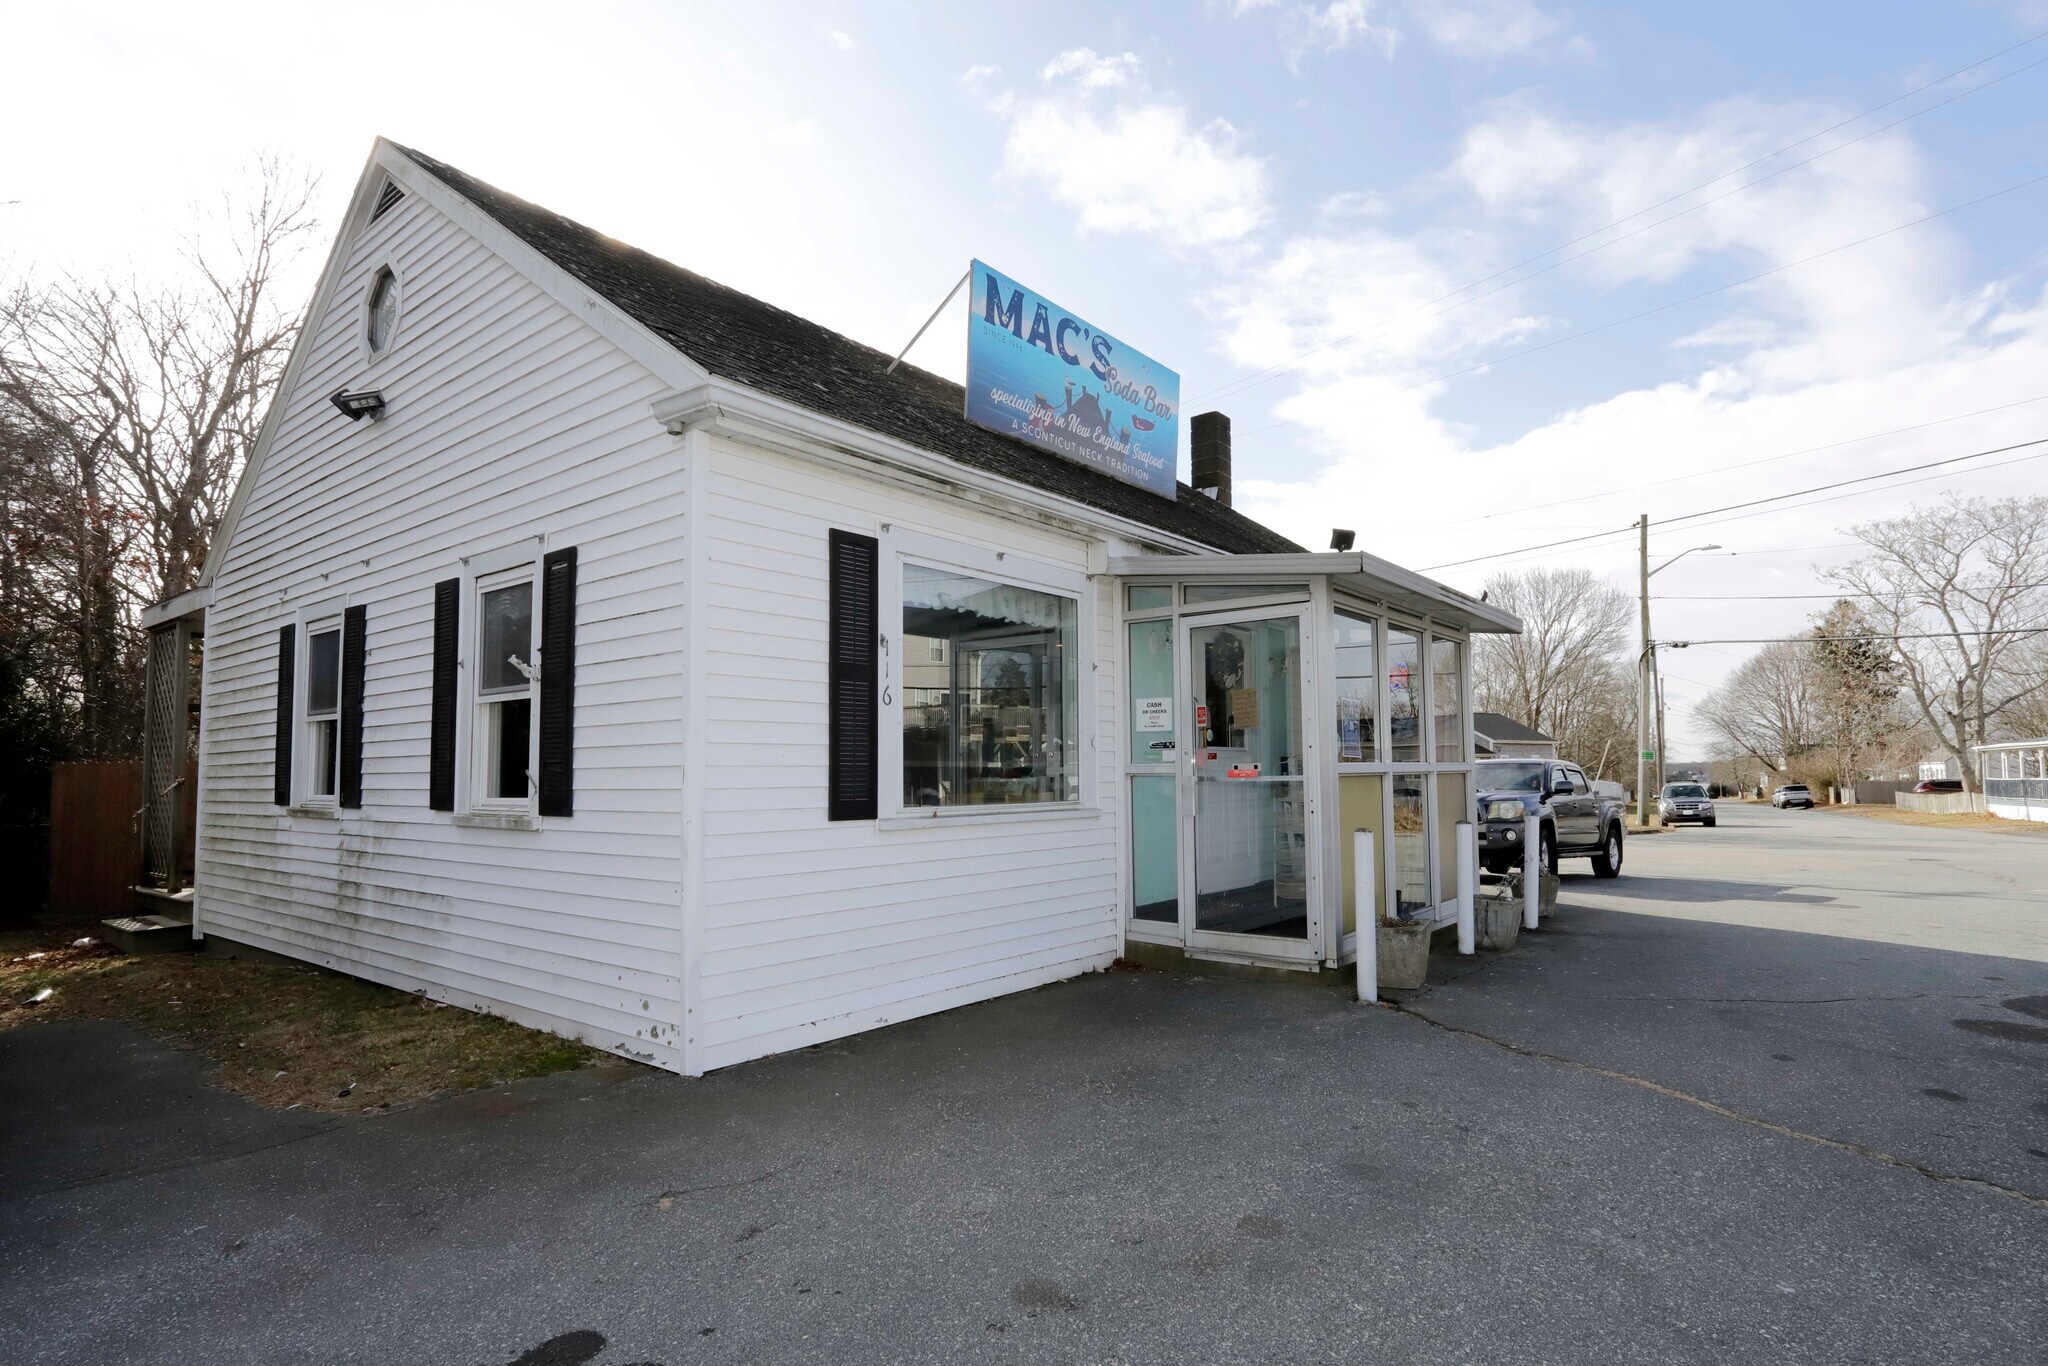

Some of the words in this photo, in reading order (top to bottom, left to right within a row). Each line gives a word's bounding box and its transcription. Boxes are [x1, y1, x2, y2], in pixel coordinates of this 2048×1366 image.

[983, 272, 1113, 381] MAC'S
[983, 325, 1007, 345] SINCE
[1103, 366, 1141, 406] Soda
[1143, 385, 1172, 421] Bar
[990, 387, 1054, 427] specializing
[1054, 412, 1067, 429] in
[1068, 413, 1092, 438] New
[1092, 426, 1131, 455] England
[1132, 443, 1164, 469] Seafood
[1012, 419, 1019, 430] A
[1021, 422, 1077, 453] SCONTICUT
[1079, 446, 1103, 463] NECK
[1105, 455, 1149, 480] TRADITION
